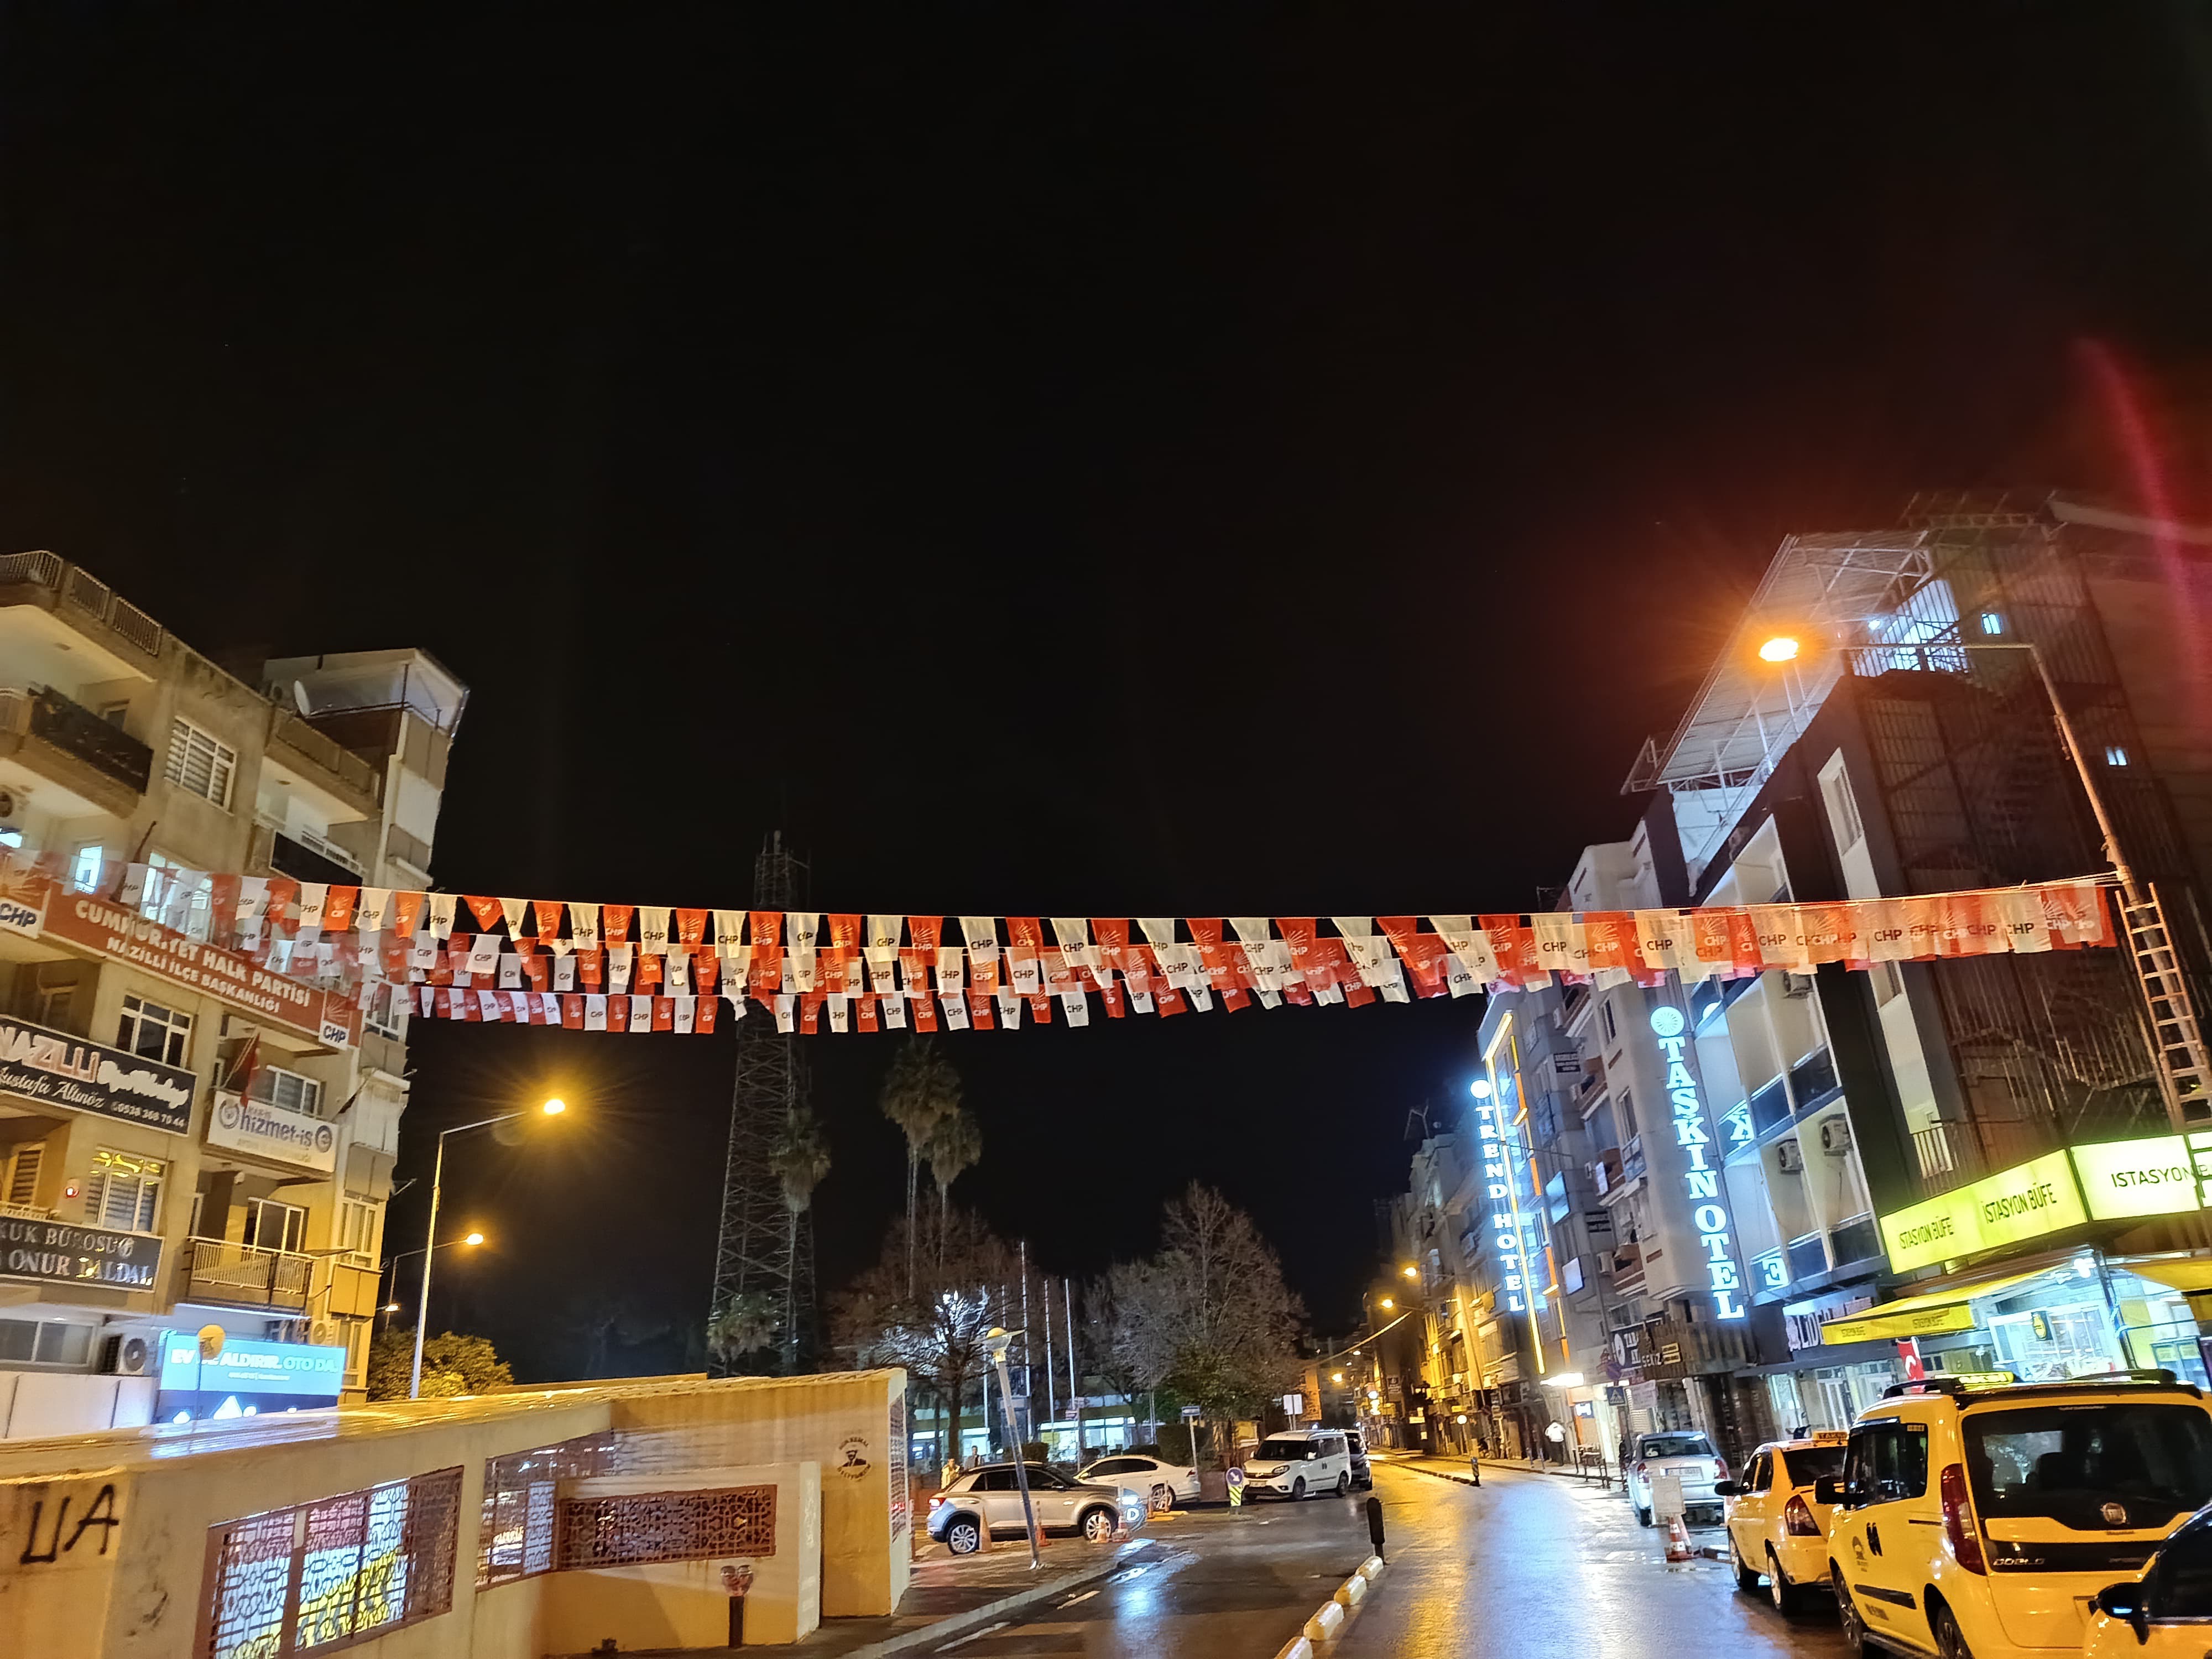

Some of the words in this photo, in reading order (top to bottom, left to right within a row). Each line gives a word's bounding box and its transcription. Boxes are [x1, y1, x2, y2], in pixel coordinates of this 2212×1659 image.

[0, 903, 37, 927] CHP
[573, 927, 593, 937] CHP
[606, 927, 624, 936] CHP
[2006, 922, 2034, 934] CHP
[643, 931, 665, 940] CHP
[679, 931, 697, 940] CHP
[718, 935, 738, 943] CHP
[1704, 935, 1726, 946] CHP
[1759, 934, 1787, 946] CHP
[1874, 930, 1902, 942] CHP
[912, 942, 932, 951] CHP
[971, 939, 994, 950] CHP
[1063, 942, 1084, 952] CHP
[1542, 942, 1567, 952] CHP
[1594, 942, 1618, 952] CHP
[1646, 940, 1673, 951] CHP
[1101, 947, 1121, 956] CHP
[169, 962, 199, 983] İLÇE
[1166, 963, 1188, 973] CHP
[1254, 967, 1274, 975] CHP
[202, 950, 247, 982] HALK
[252, 971, 311, 1008] PARTİSİ
[1013, 970, 1034, 978] CHP
[323, 1025, 347, 1044] CHP
[2027, 1182, 2057, 1210] BÜFE
[1475, 1105, 1509, 1199] TREND
[1493, 1213, 1526, 1312] HOTEL
[1898, 1224, 1933, 1249] STASYON
[8, 1249, 71, 1276] ONUR
[1694, 1204, 1745, 1319] OTEL
[283, 1356, 314, 1371] OTO
